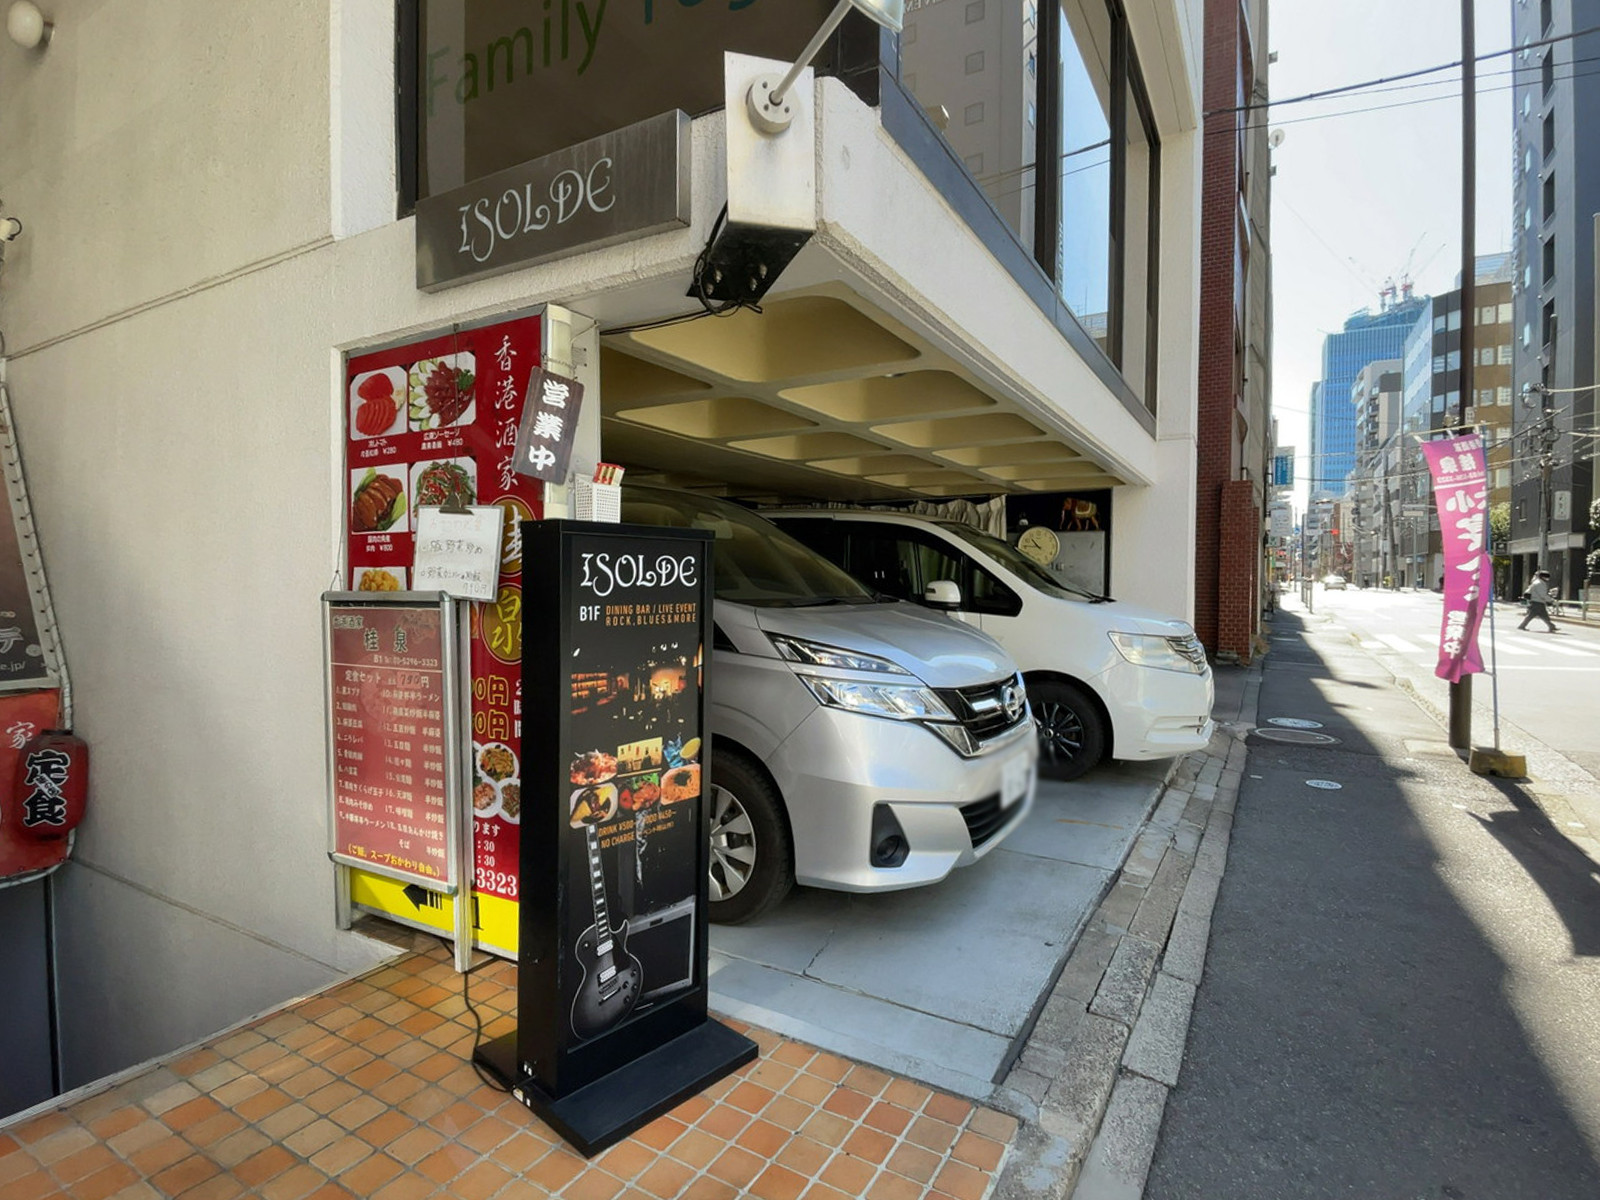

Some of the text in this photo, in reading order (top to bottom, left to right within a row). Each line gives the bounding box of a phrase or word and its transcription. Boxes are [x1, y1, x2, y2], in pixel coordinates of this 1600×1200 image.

[427, 0, 606, 117] Family
[459, 158, 616, 263] ISOLDE
[495, 335, 518, 491] 香港酒家
[528, 378, 570, 471] 営業中
[580, 553, 697, 597] ISOLDE
[579, 605, 601, 622] B1F
[605, 604, 633, 616] DINING
[635, 604, 651, 615] BAR
[658, 603, 674, 614] LIVE
[675, 602, 697, 613] EVENT
[474, 675, 508, 706] 0円
[474, 709, 508, 740] 0円
[23, 749, 71, 826] 定食
[598, 824, 618, 837] DRINK
[601, 831, 636, 849] NO CHARGE
[476, 867, 518, 897] 3323
